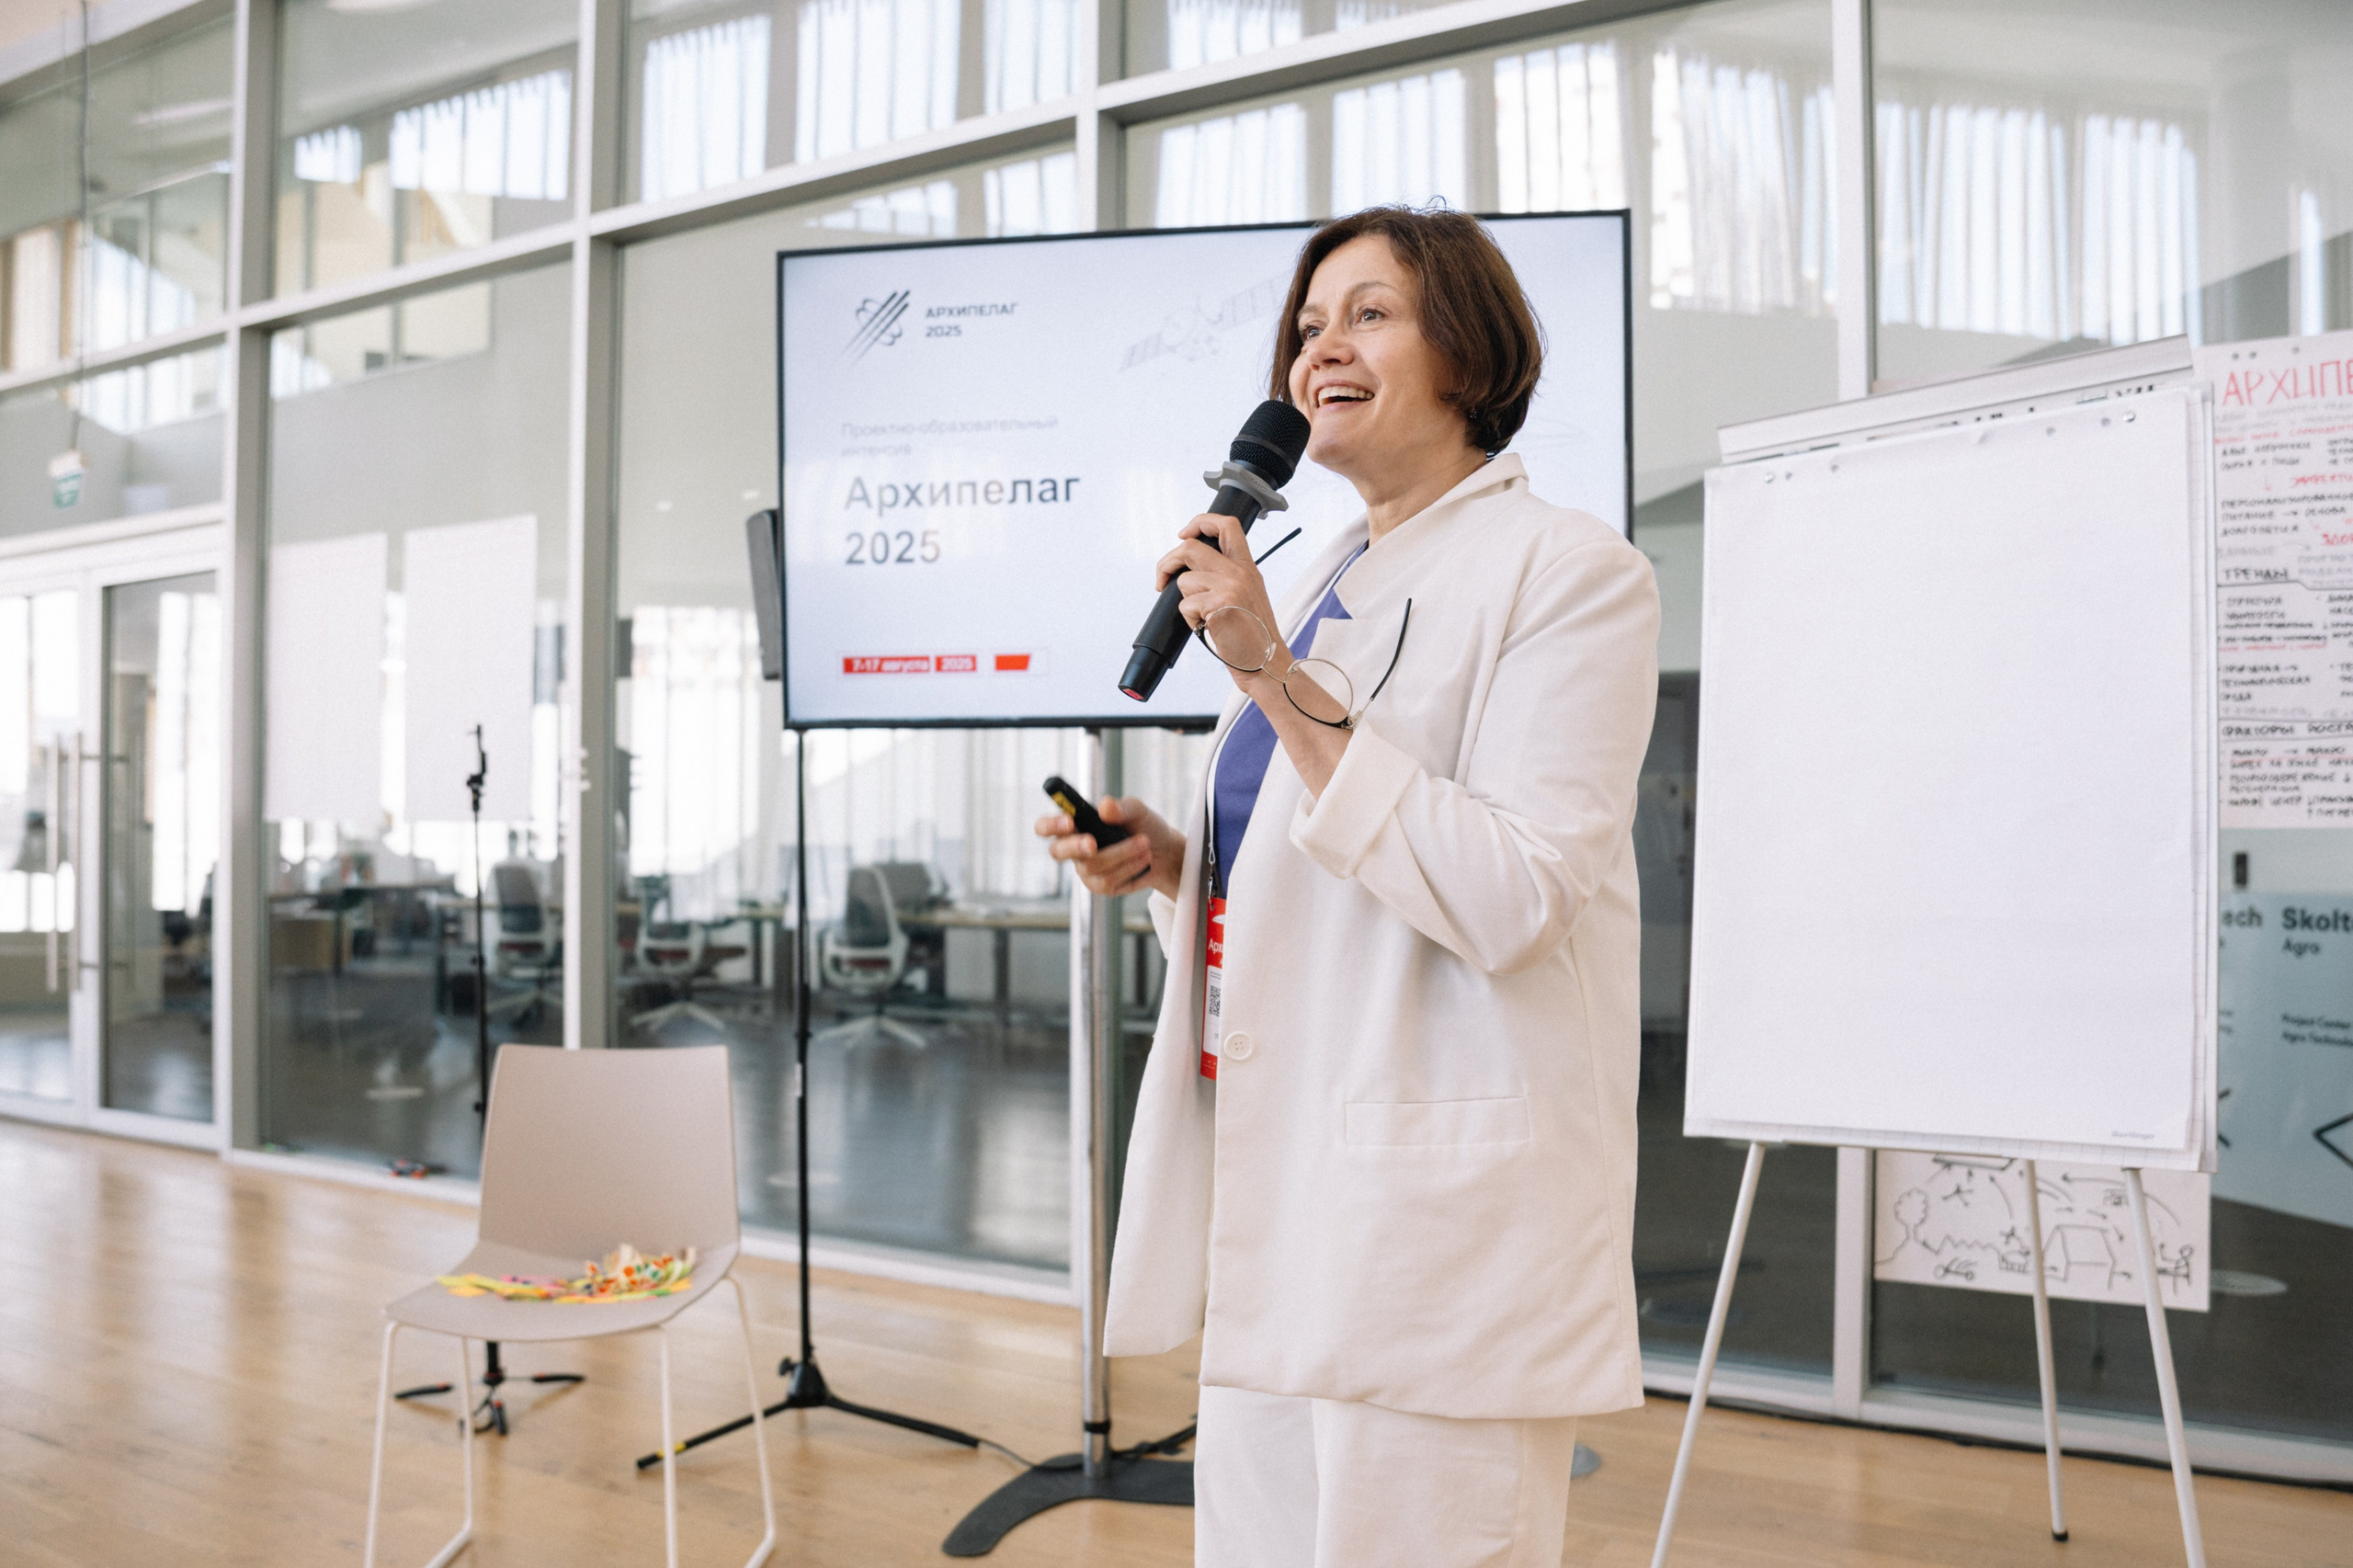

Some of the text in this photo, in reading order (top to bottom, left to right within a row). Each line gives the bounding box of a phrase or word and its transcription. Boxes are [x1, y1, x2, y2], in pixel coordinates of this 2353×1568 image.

[926, 303, 1018, 319] АРХИПЕЛАГ
[926, 325, 962, 338] 2025
[845, 475, 1080, 517] Архипелаг
[845, 530, 942, 564] 2025
[2222, 905, 2353, 933] ech Skolt
[2282, 937, 2320, 957] Agro
